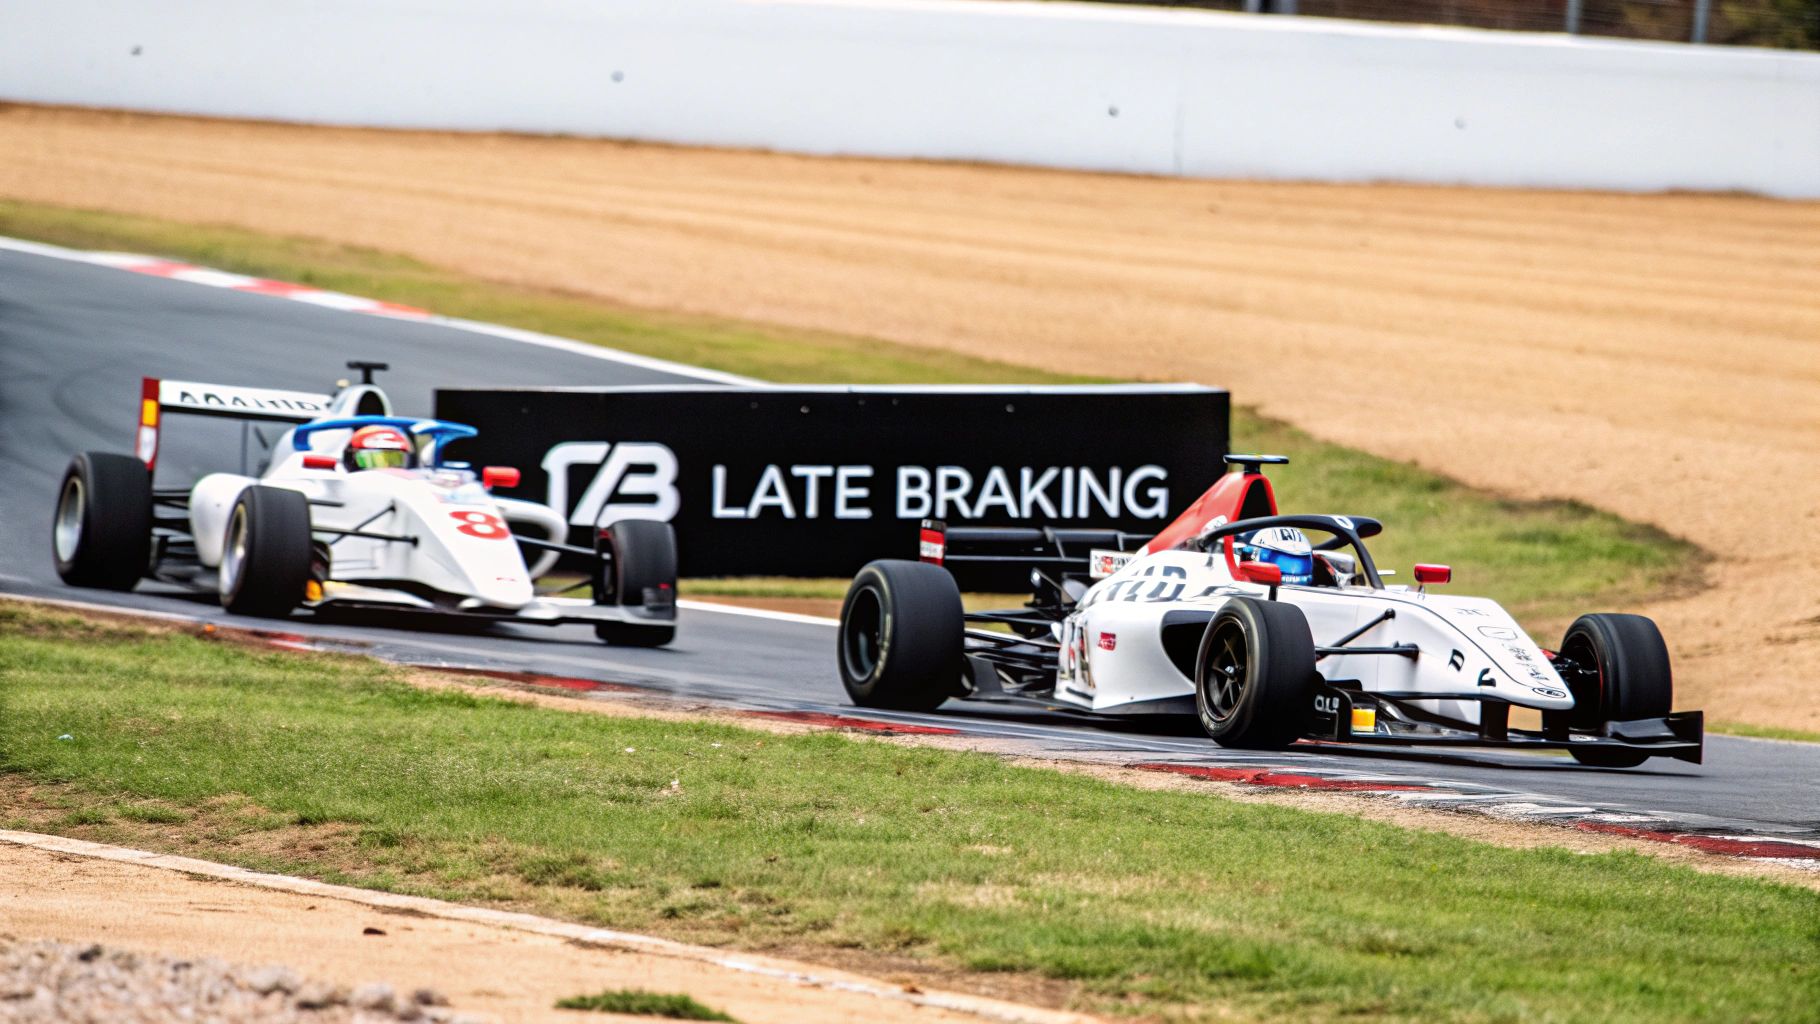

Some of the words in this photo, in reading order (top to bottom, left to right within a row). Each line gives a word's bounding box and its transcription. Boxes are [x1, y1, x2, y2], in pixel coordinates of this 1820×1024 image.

[713, 465, 873, 519] LATE
[897, 465, 1168, 519] BRAKING
[448, 511, 510, 541] 8
